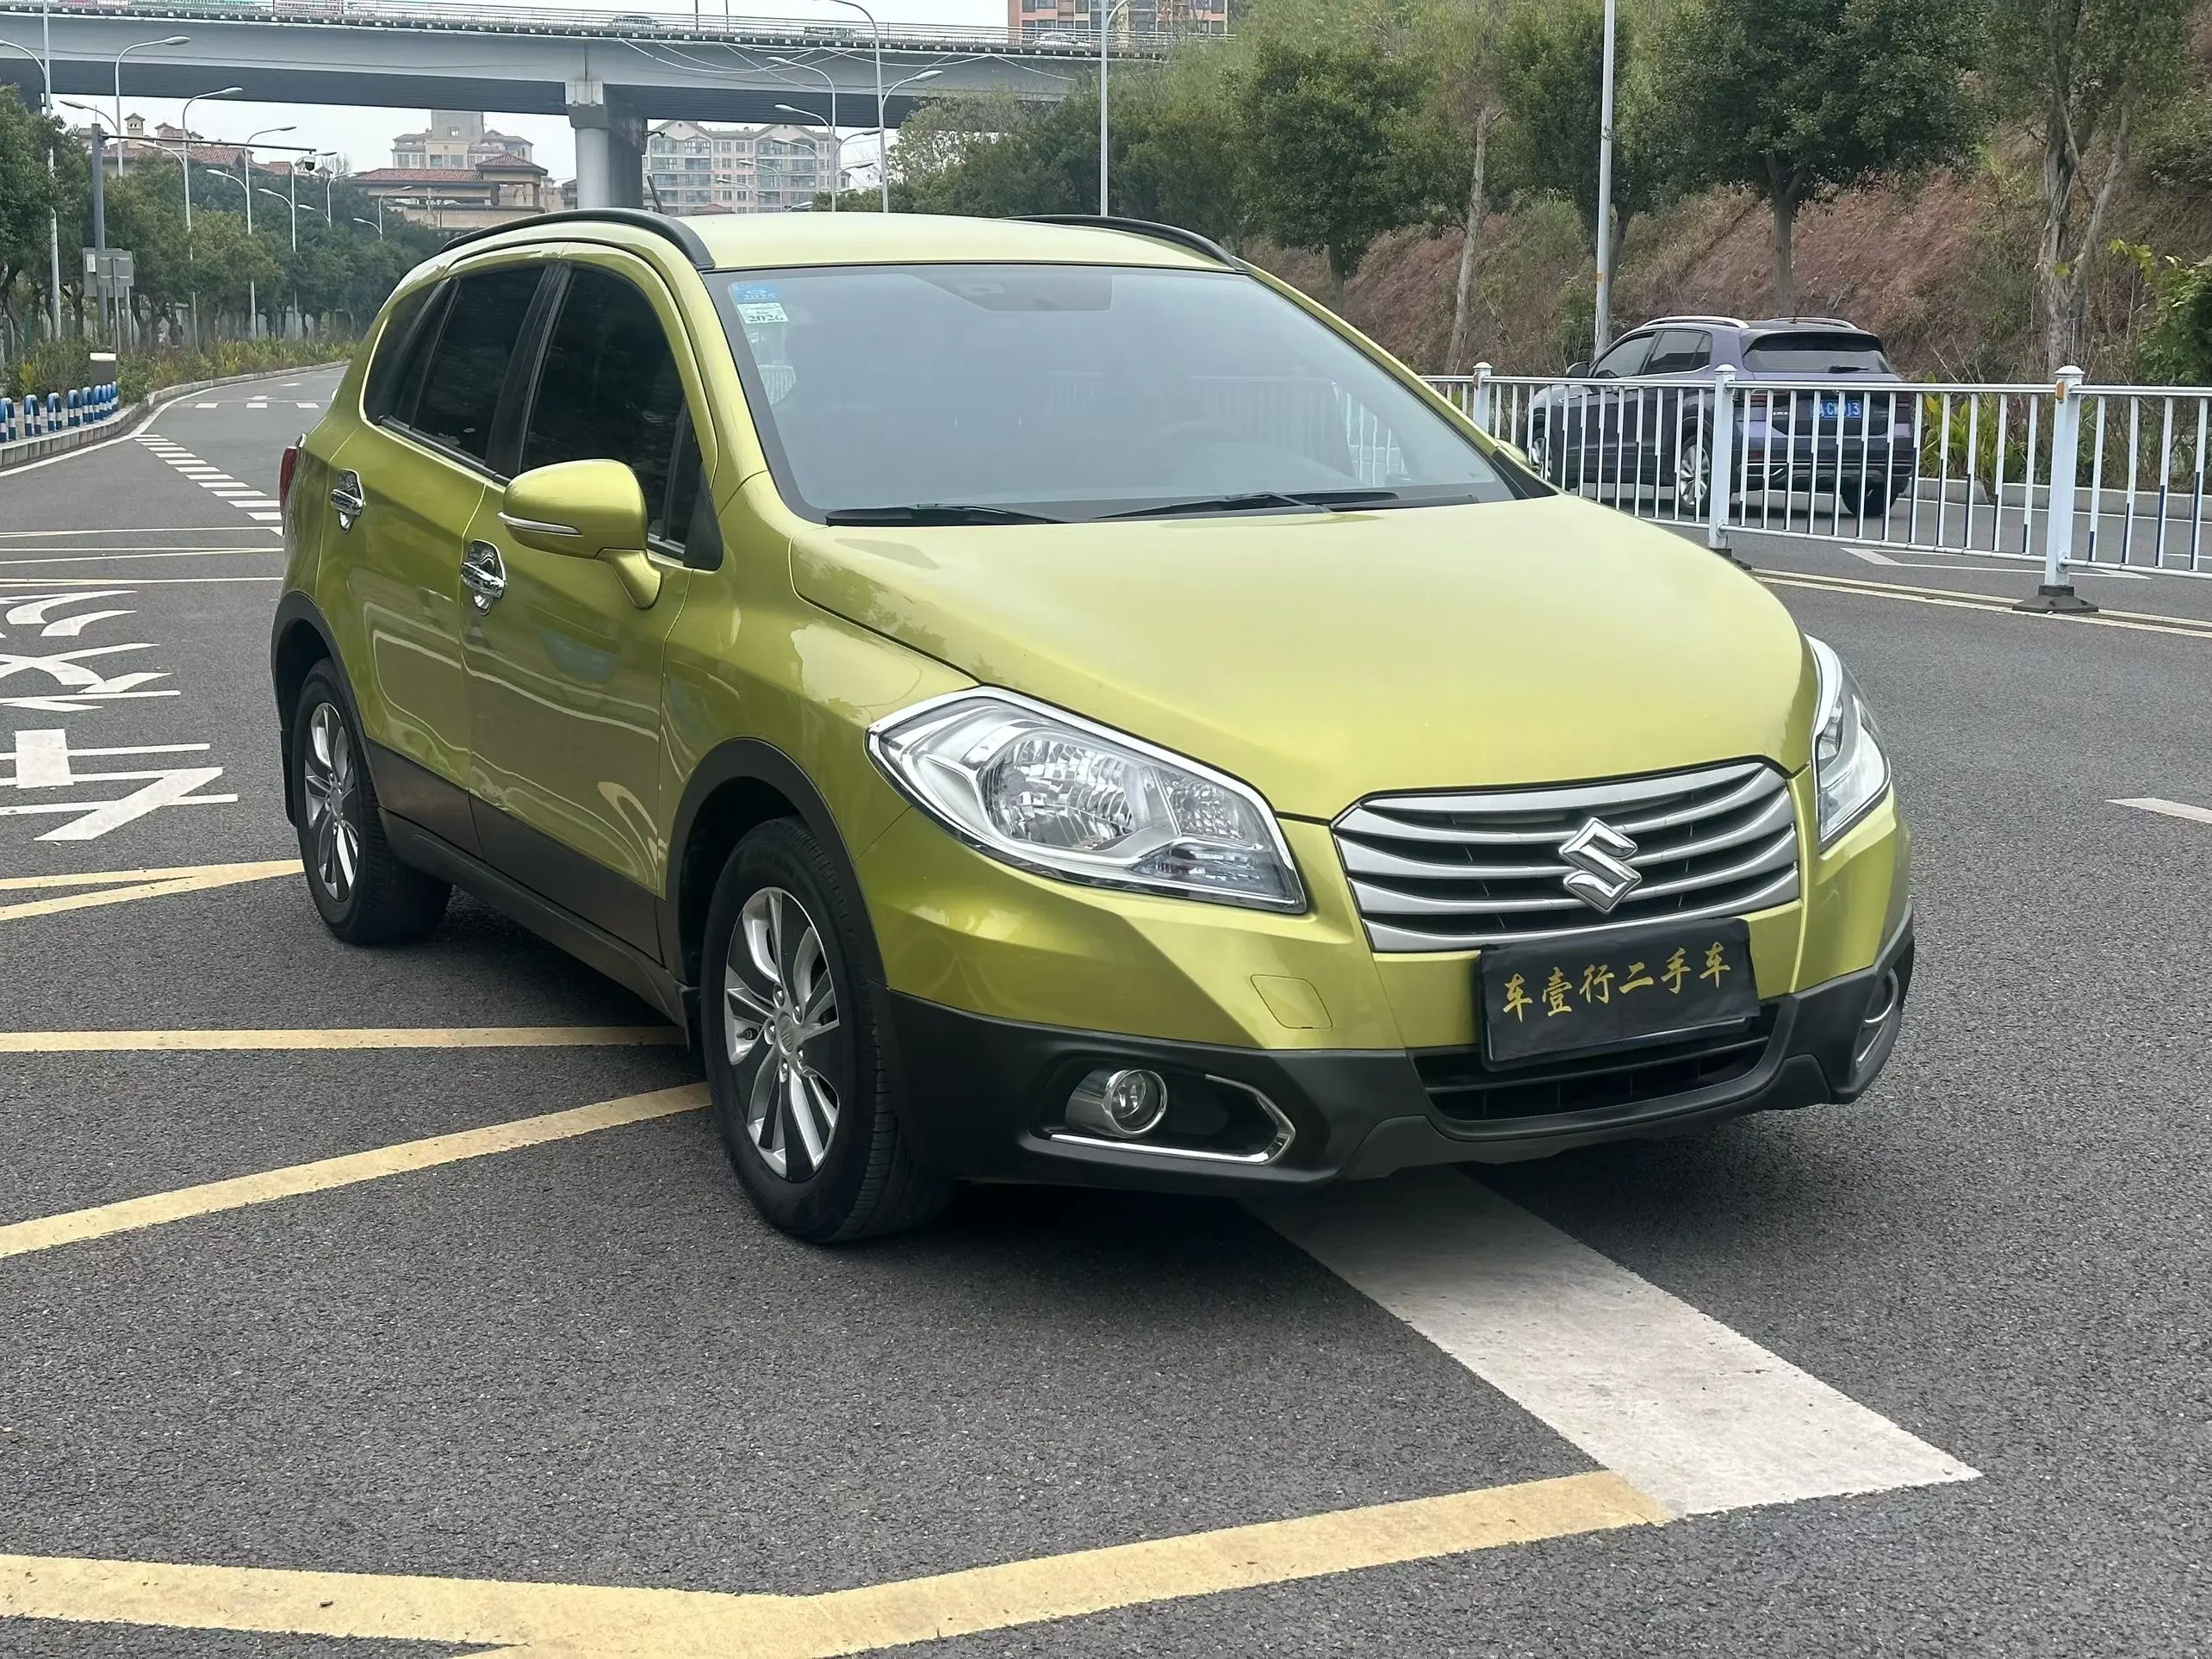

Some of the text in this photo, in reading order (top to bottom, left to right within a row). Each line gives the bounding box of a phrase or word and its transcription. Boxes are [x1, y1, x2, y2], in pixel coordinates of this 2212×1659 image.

[1502, 941, 1731, 1023] 车壹行二手车
